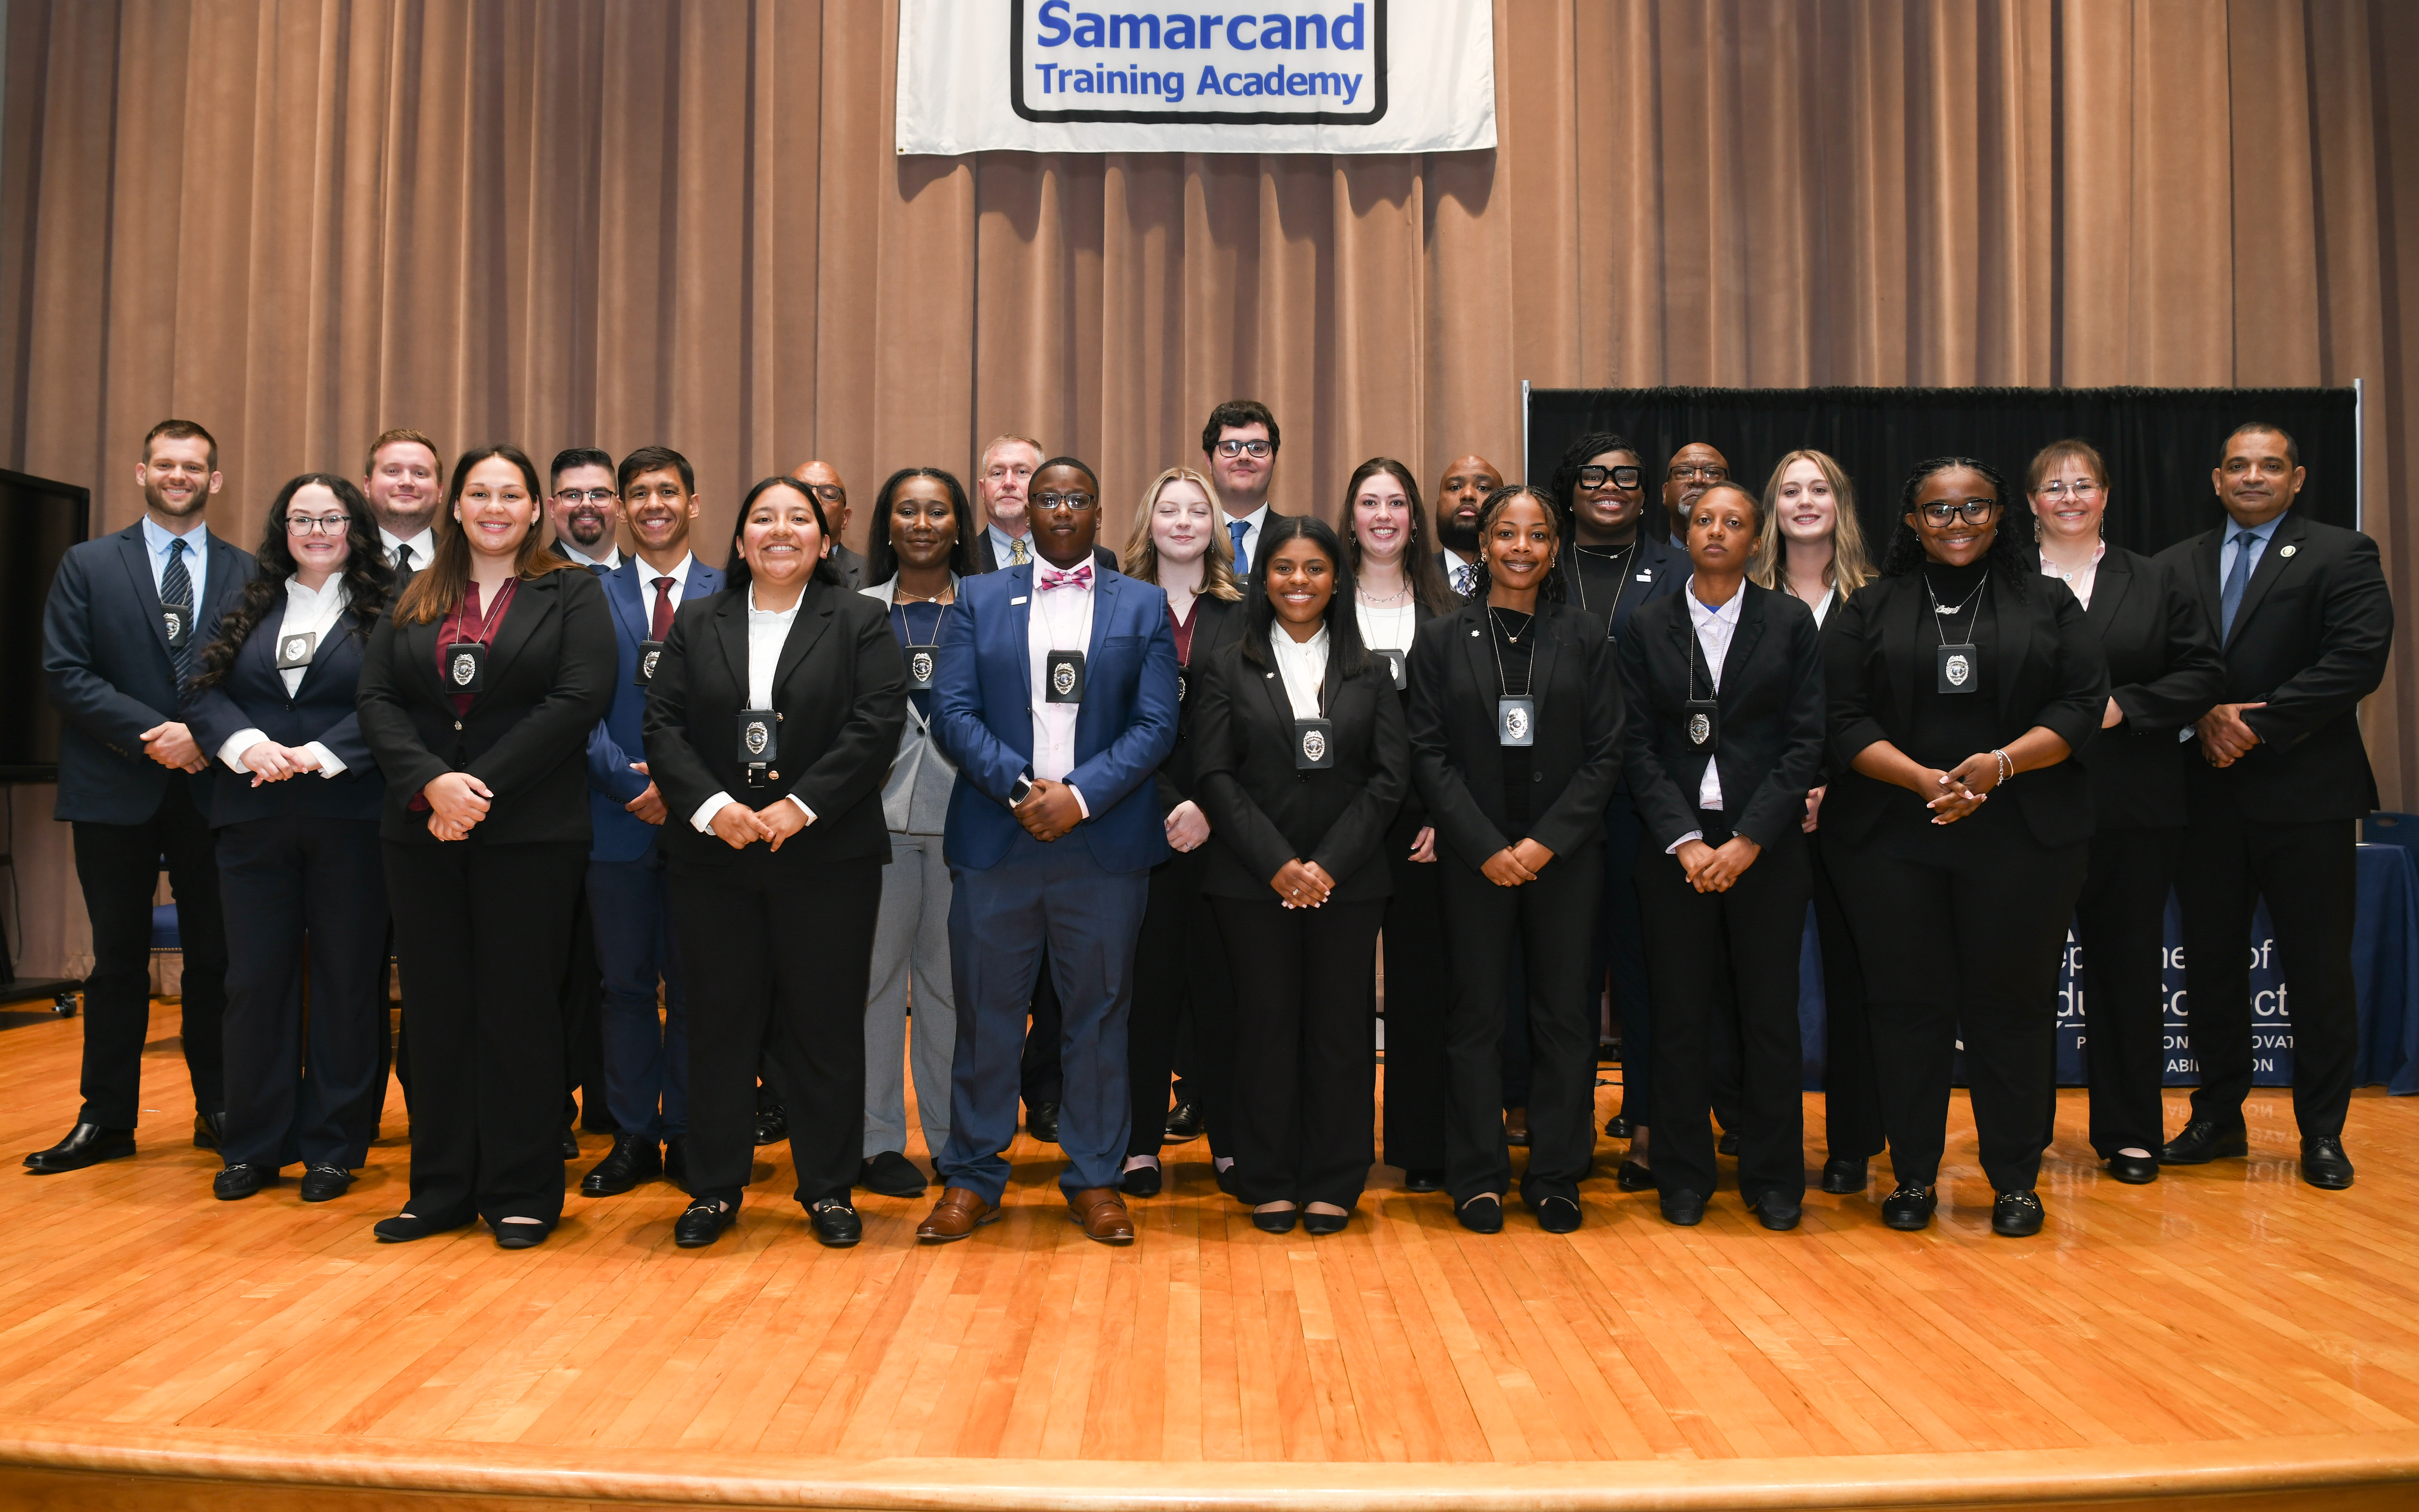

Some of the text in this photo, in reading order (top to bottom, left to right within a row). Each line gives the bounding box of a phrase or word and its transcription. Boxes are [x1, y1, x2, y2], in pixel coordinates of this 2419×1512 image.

[1038, 0, 1364, 50] Samarcand
[1036, 63, 1362, 105] Training Academy
